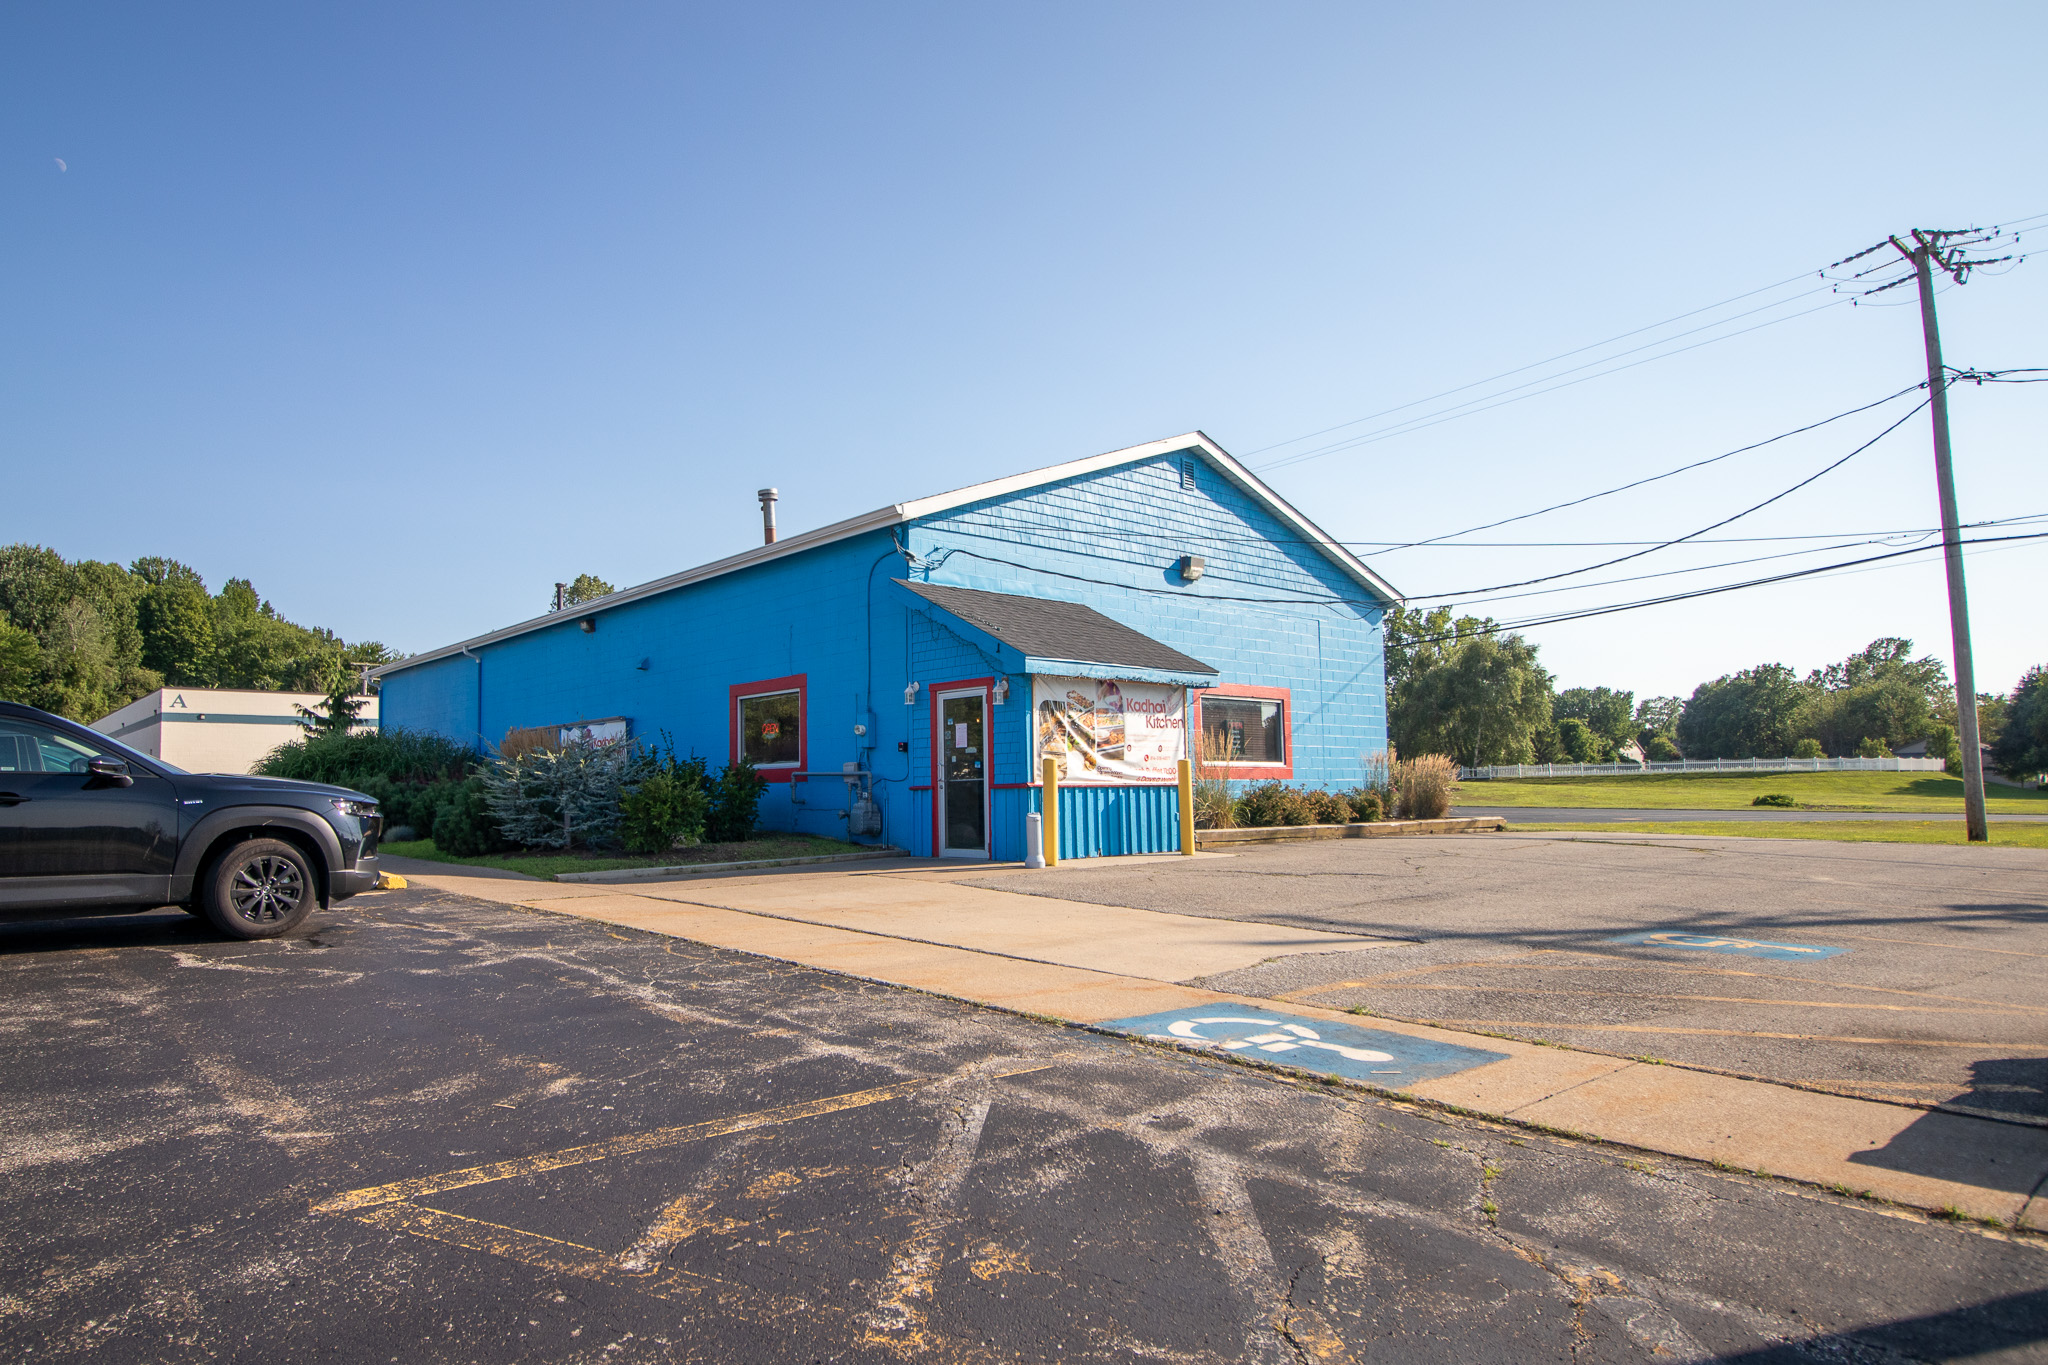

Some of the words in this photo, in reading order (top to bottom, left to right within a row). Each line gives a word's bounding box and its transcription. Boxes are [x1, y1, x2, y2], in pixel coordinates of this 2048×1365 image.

[169, 693, 188, 709] A
[1126, 697, 1166, 714] Kadhai
[761, 723, 780, 734] OPEN
[1145, 715, 1184, 729] Kitchen
